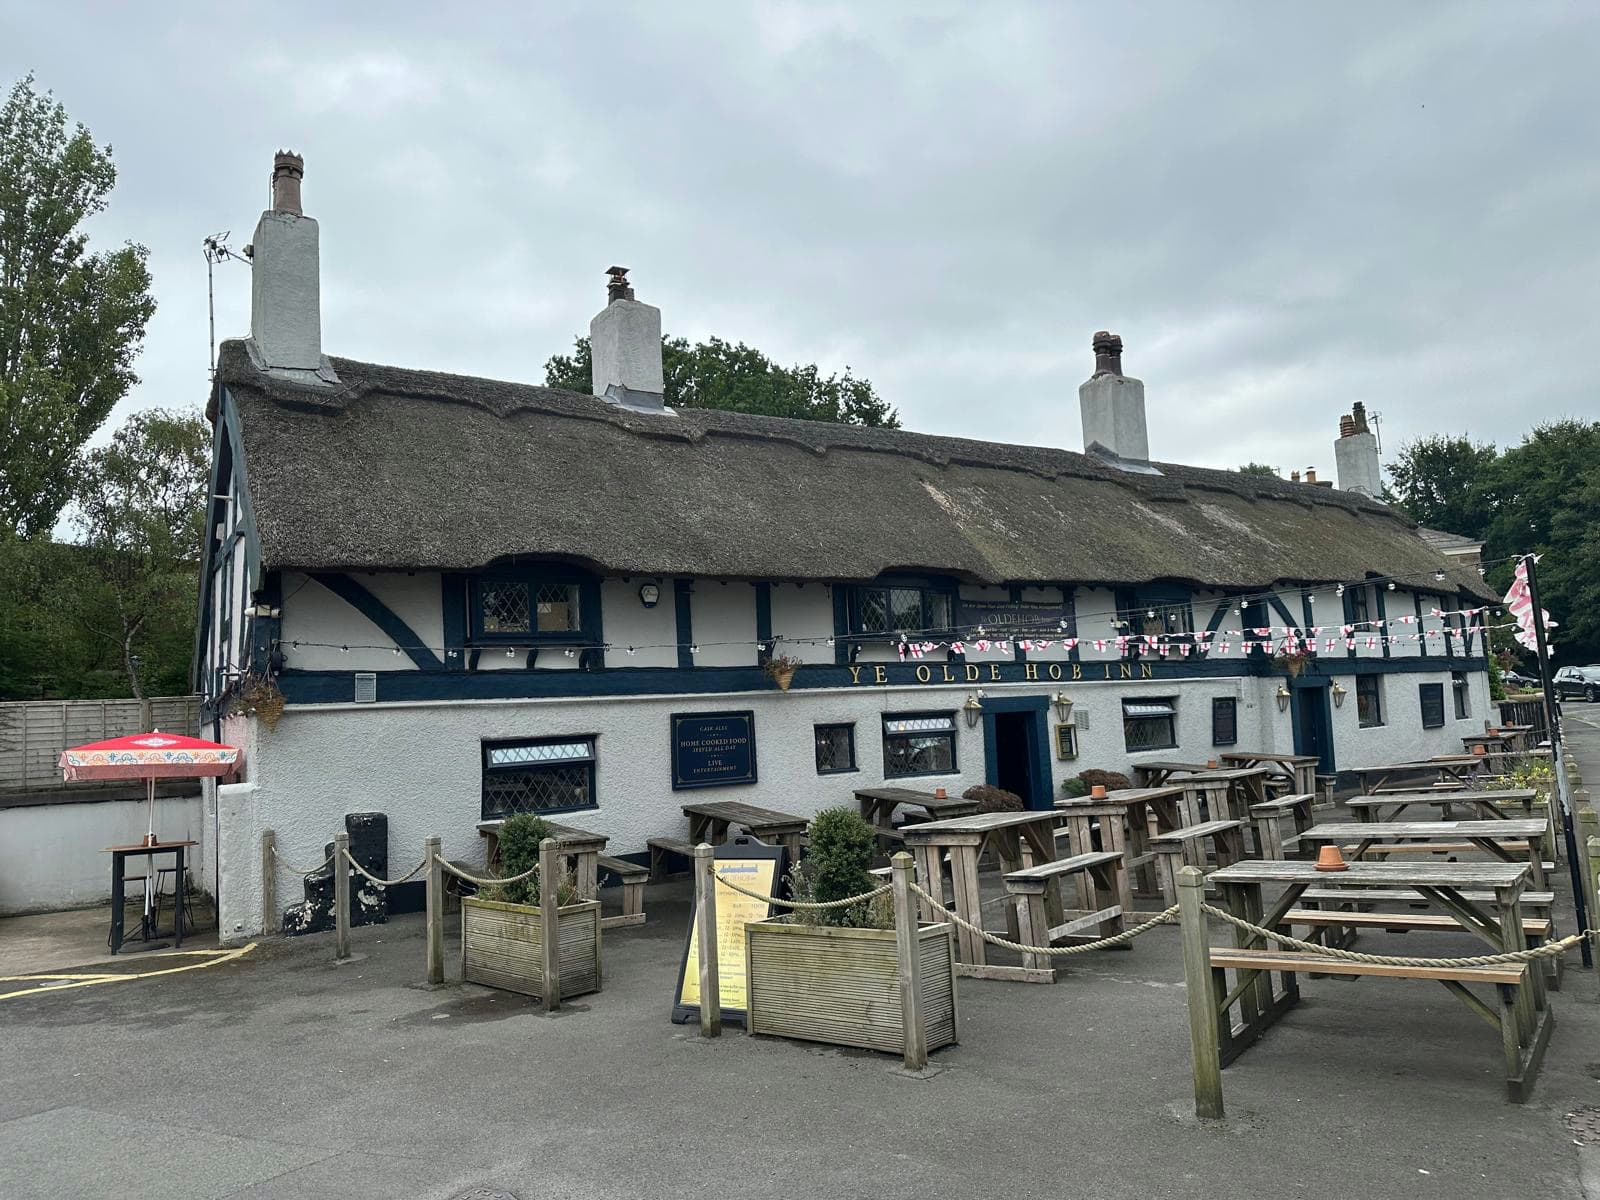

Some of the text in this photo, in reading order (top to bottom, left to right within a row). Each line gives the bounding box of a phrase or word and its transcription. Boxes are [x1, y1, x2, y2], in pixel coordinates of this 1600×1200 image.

[849, 661, 1153, 684] YE OLDE HOB INN
[680, 740, 700, 748] HOME
[701, 738, 729, 746] COOKED
[707, 759, 723, 767] LIVE
[693, 765, 737, 774] ENTERTAINMENT
